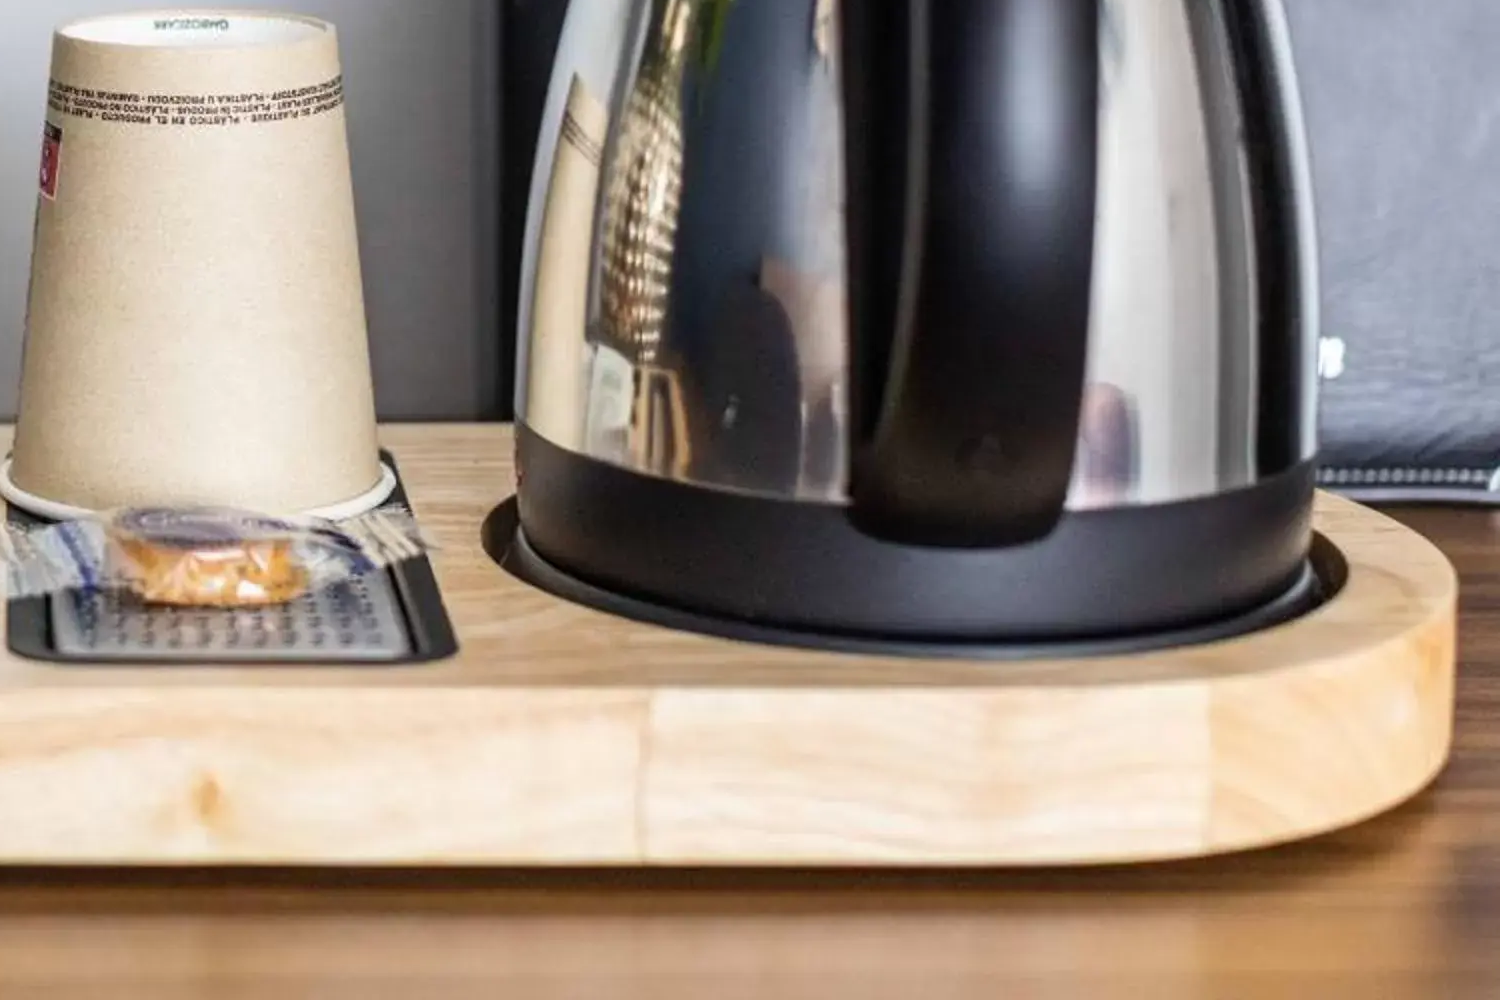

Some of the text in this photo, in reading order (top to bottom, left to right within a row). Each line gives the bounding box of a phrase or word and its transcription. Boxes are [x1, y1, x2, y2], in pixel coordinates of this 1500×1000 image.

[218, 93, 264, 104] PLASTIKA
[155, 116, 168, 125] EL
[172, 116, 185, 125] EN
